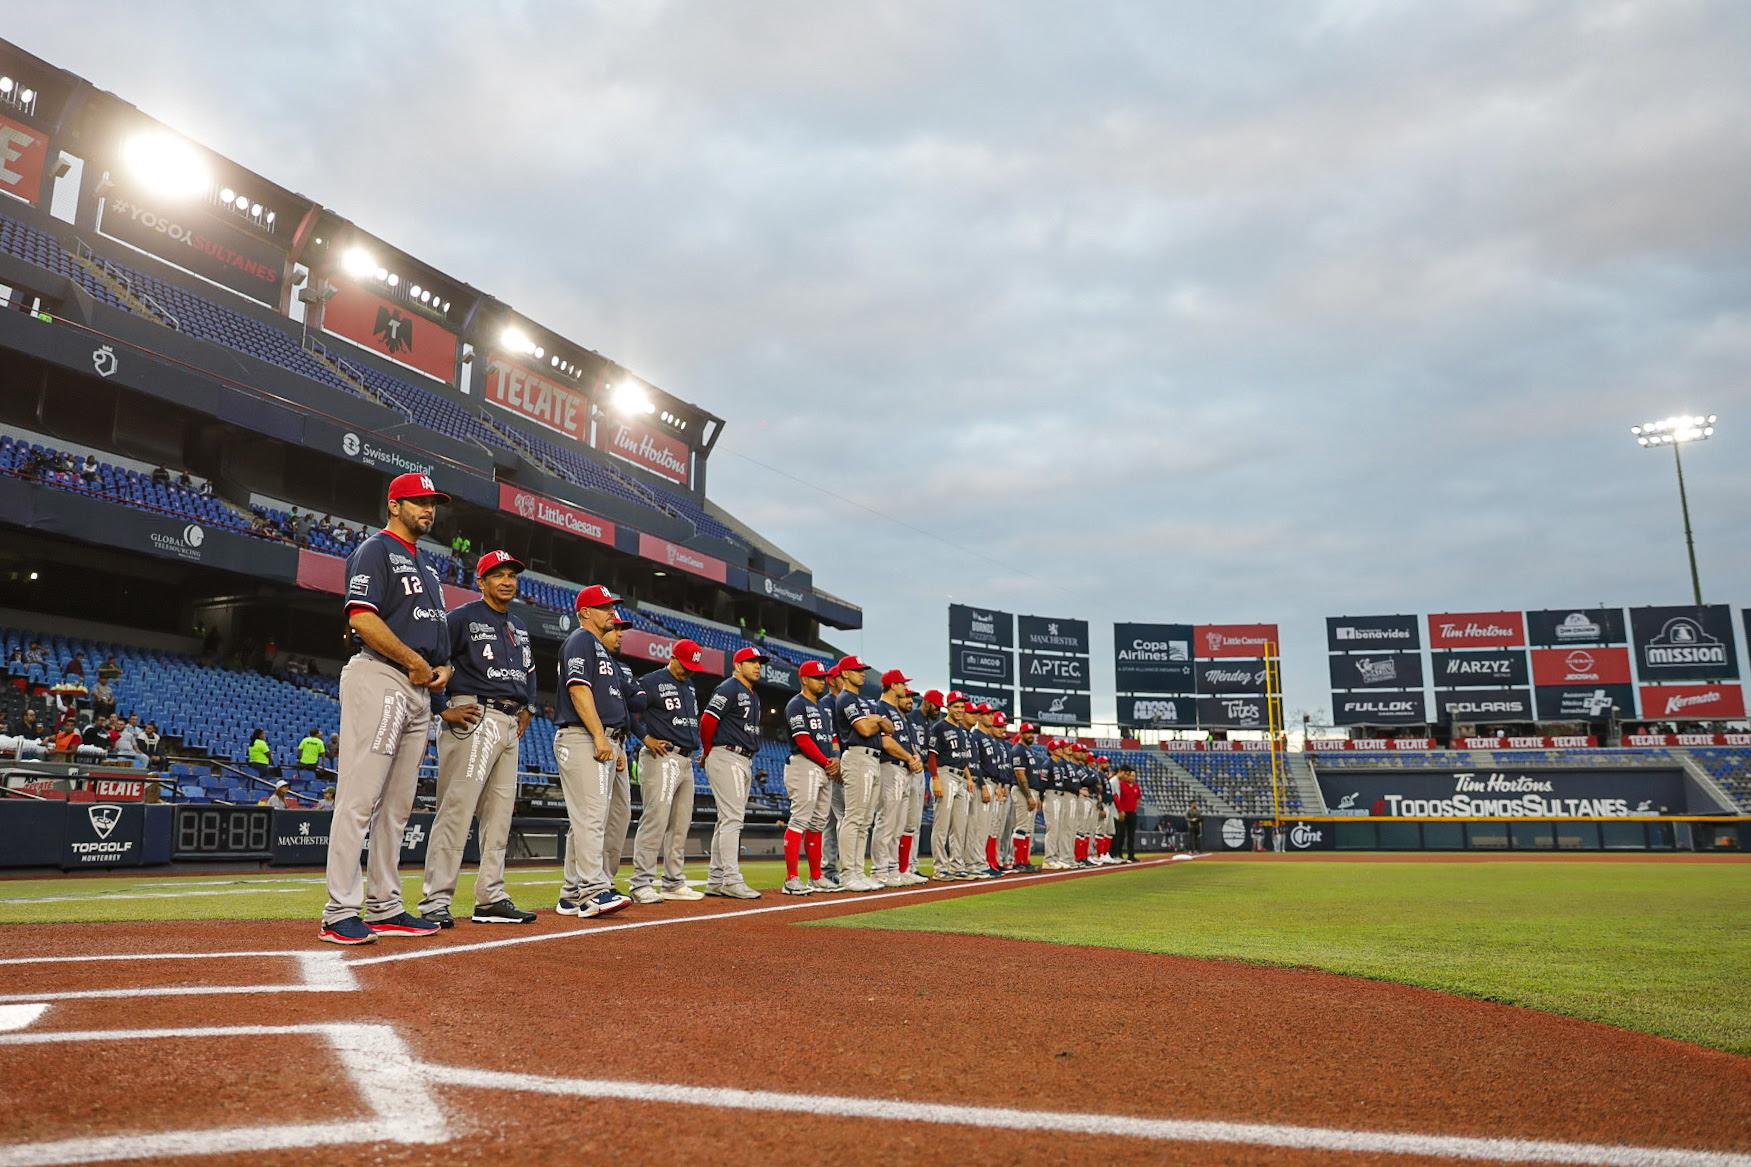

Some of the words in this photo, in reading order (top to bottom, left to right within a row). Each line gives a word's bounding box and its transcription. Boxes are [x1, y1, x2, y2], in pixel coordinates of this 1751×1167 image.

[494, 364, 579, 431] TECATE
[614, 424, 638, 455] Tim
[639, 434, 686, 475] Hortons
[538, 503, 565, 526] Little
[565, 513, 602, 538] Caesars
[150, 533, 186, 547] GLOBAL
[401, 575, 423, 595] 12
[1355, 628, 1410, 640] benavides
[1440, 624, 1463, 638] Tim
[1464, 623, 1513, 638] Hortons
[1030, 634, 1078, 646] MANCHESTER
[1133, 640, 1167, 651] Copa
[482, 643, 493, 660] 4
[1118, 650, 1168, 661] Airlines
[599, 660, 614, 676] 25
[665, 698, 682, 710] 63
[744, 707, 750, 718] 7
[809, 718, 822, 730] 62
[1168, 741, 1196, 750] TECATE
[1202, 741, 1232, 750] TCATE
[1311, 740, 1345, 750] TECATE
[1352, 739, 1386, 749] TECATE
[1393, 739, 1429, 749] TECATE
[1464, 738, 1499, 749] TECATE
[1508, 737, 1544, 748] TECATE
[1551, 736, 1588, 747] TECATE
[1629, 735, 1666, 746] TECATE
[1676, 735, 1715, 745] TECATE
[1453, 773, 1486, 792] Tim
[1487, 773, 1553, 792] Hortons
[278, 836, 329, 846] MANCHESTER
[72, 842, 132, 853] TOPGOLF
[81, 854, 122, 862] MONTERREY
